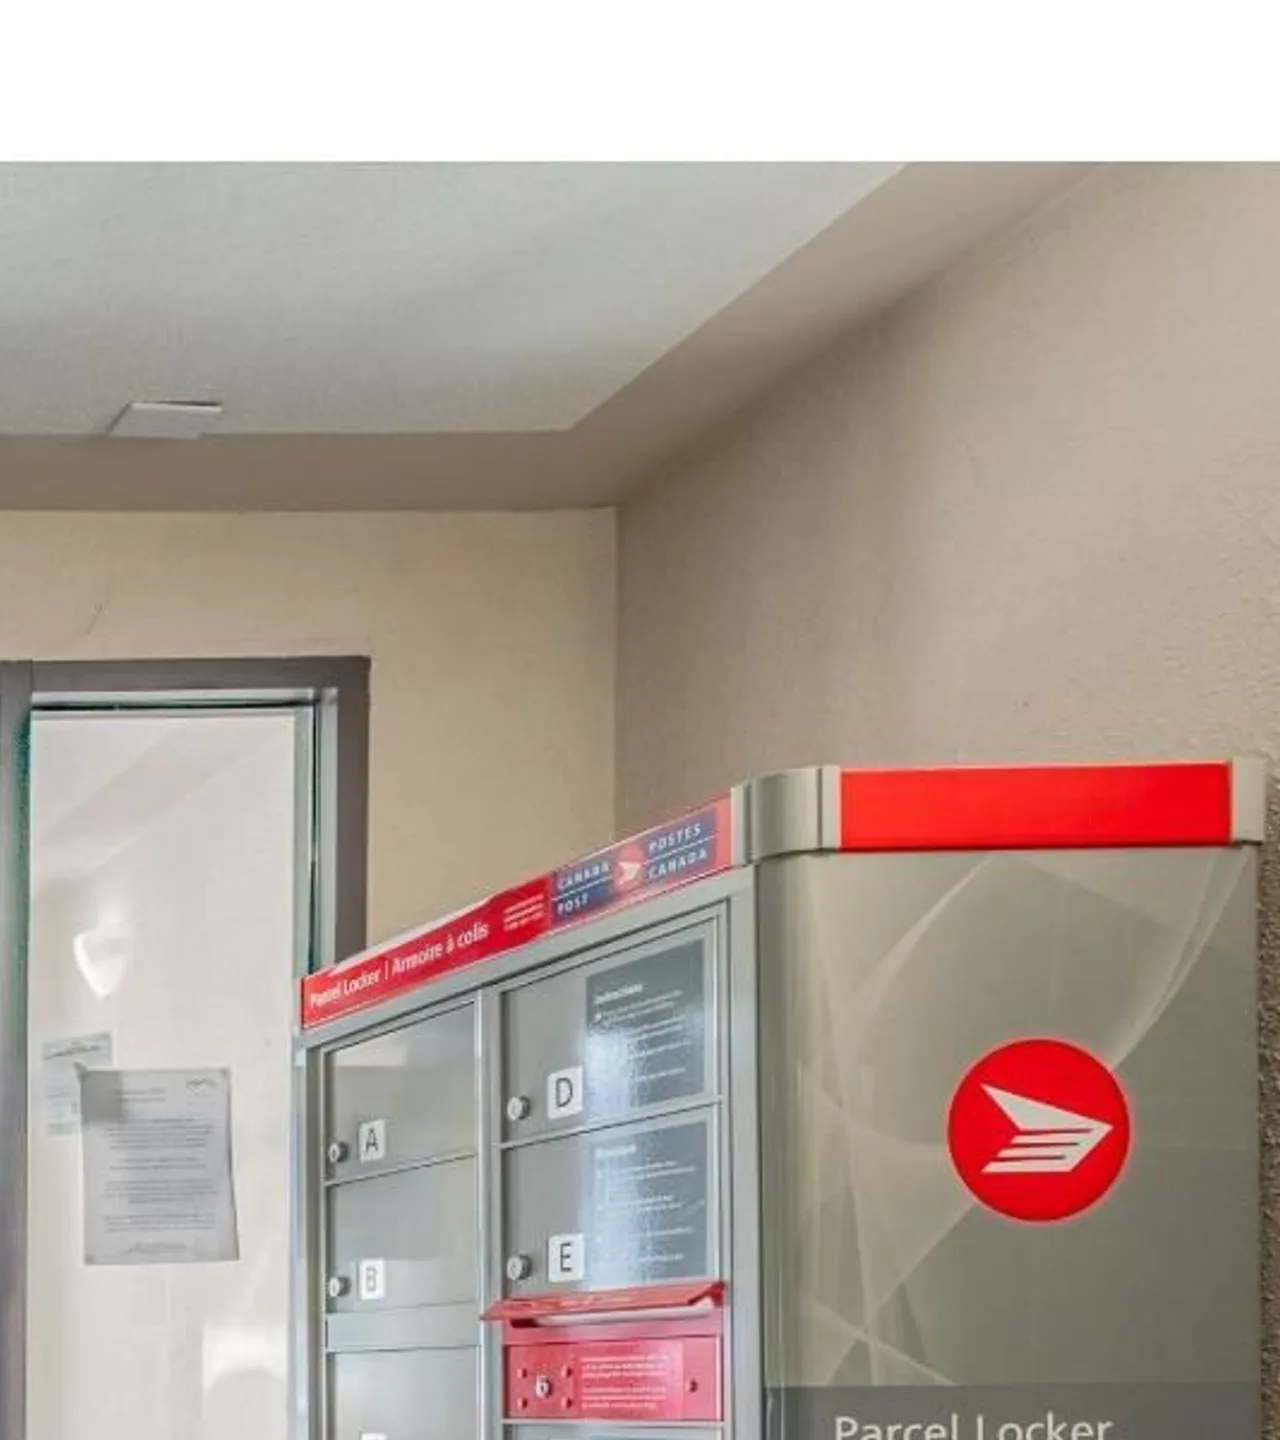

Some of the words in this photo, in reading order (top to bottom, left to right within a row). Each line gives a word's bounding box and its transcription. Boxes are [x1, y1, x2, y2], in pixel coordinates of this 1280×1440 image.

[648, 823, 701, 854] POSTES
[557, 860, 610, 890] CANADA
[648, 849, 708, 880] CANADA
[557, 894, 589, 914] POST
[343, 965, 381, 993] Locker
[391, 942, 443, 977] Armoire
[456, 921, 489, 947] colis
[555, 1077, 573, 1107] D
[365, 1127, 379, 1152] A
[559, 1242, 572, 1272] E
[365, 1266, 378, 1292] B
